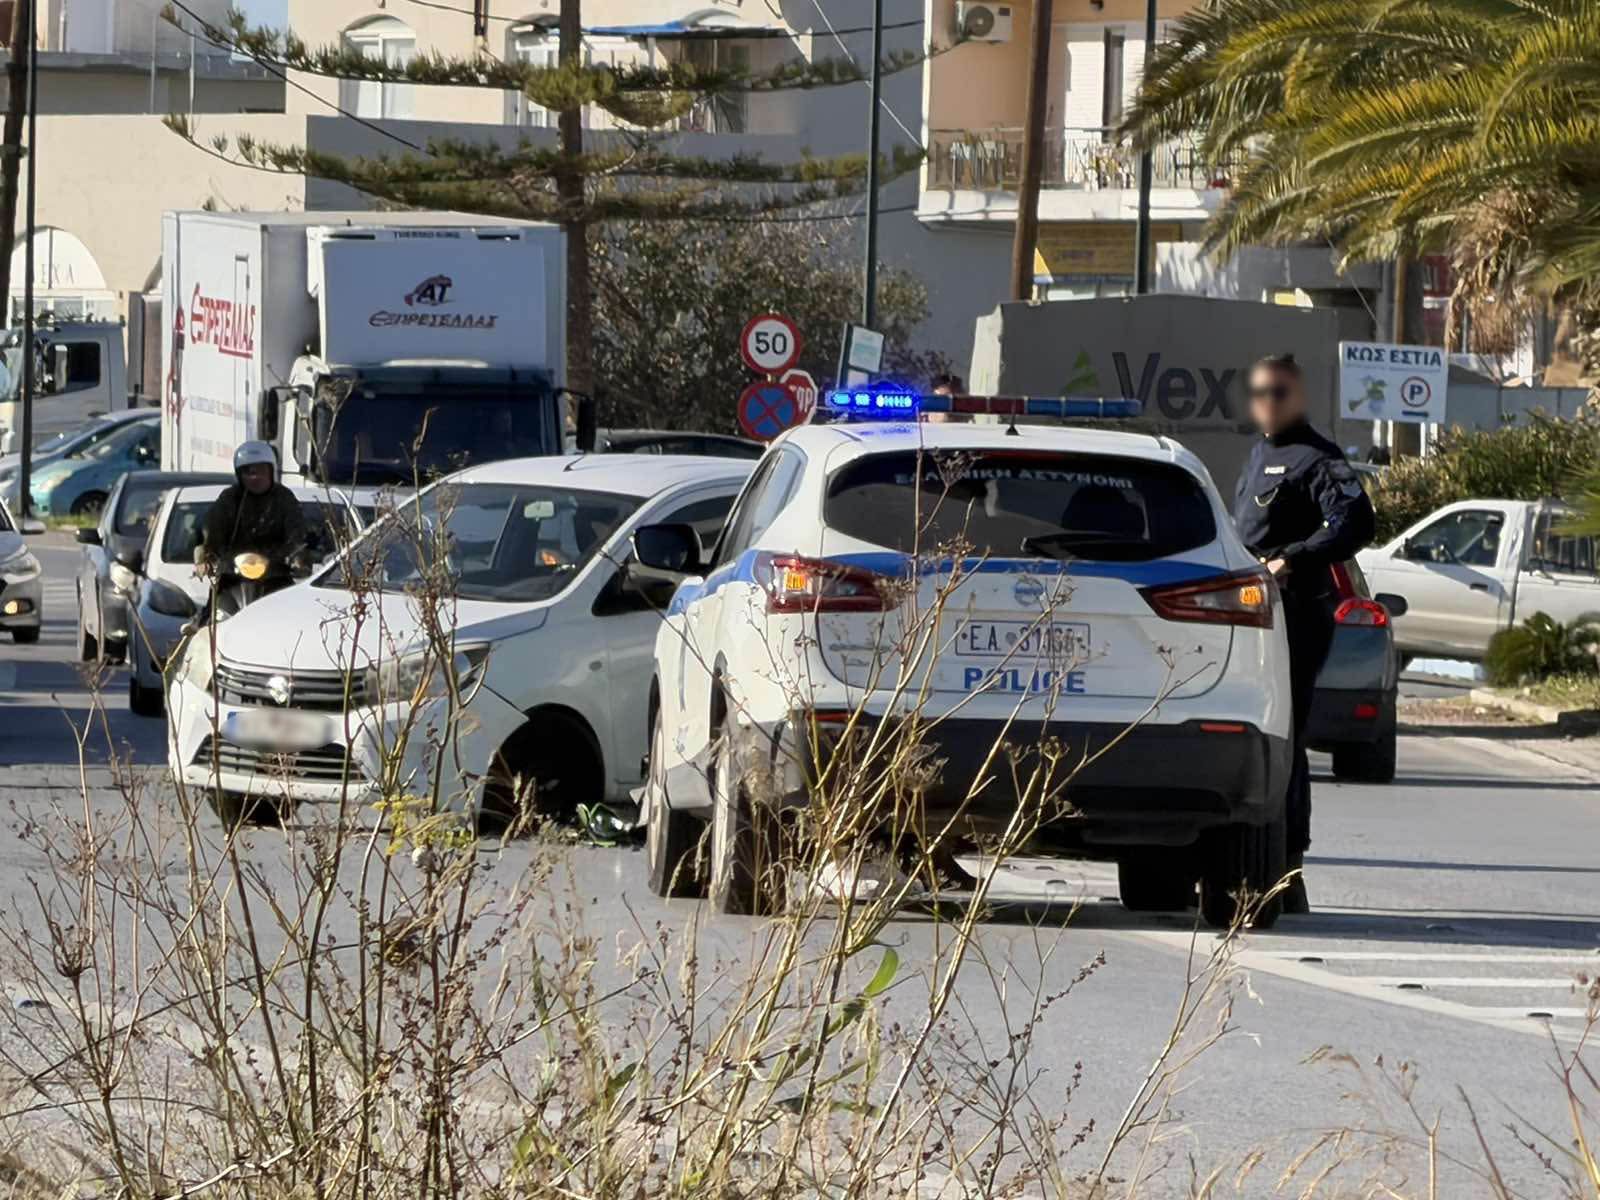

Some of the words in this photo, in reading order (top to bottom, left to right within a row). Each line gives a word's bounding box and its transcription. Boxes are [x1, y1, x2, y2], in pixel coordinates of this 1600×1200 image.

[754, 331, 788, 356] 50
[1347, 346, 1386, 362] ΚΩΣ
[1389, 350, 1442, 367] ΕΣΤΙΑ
[964, 667, 1086, 693] POLICE
